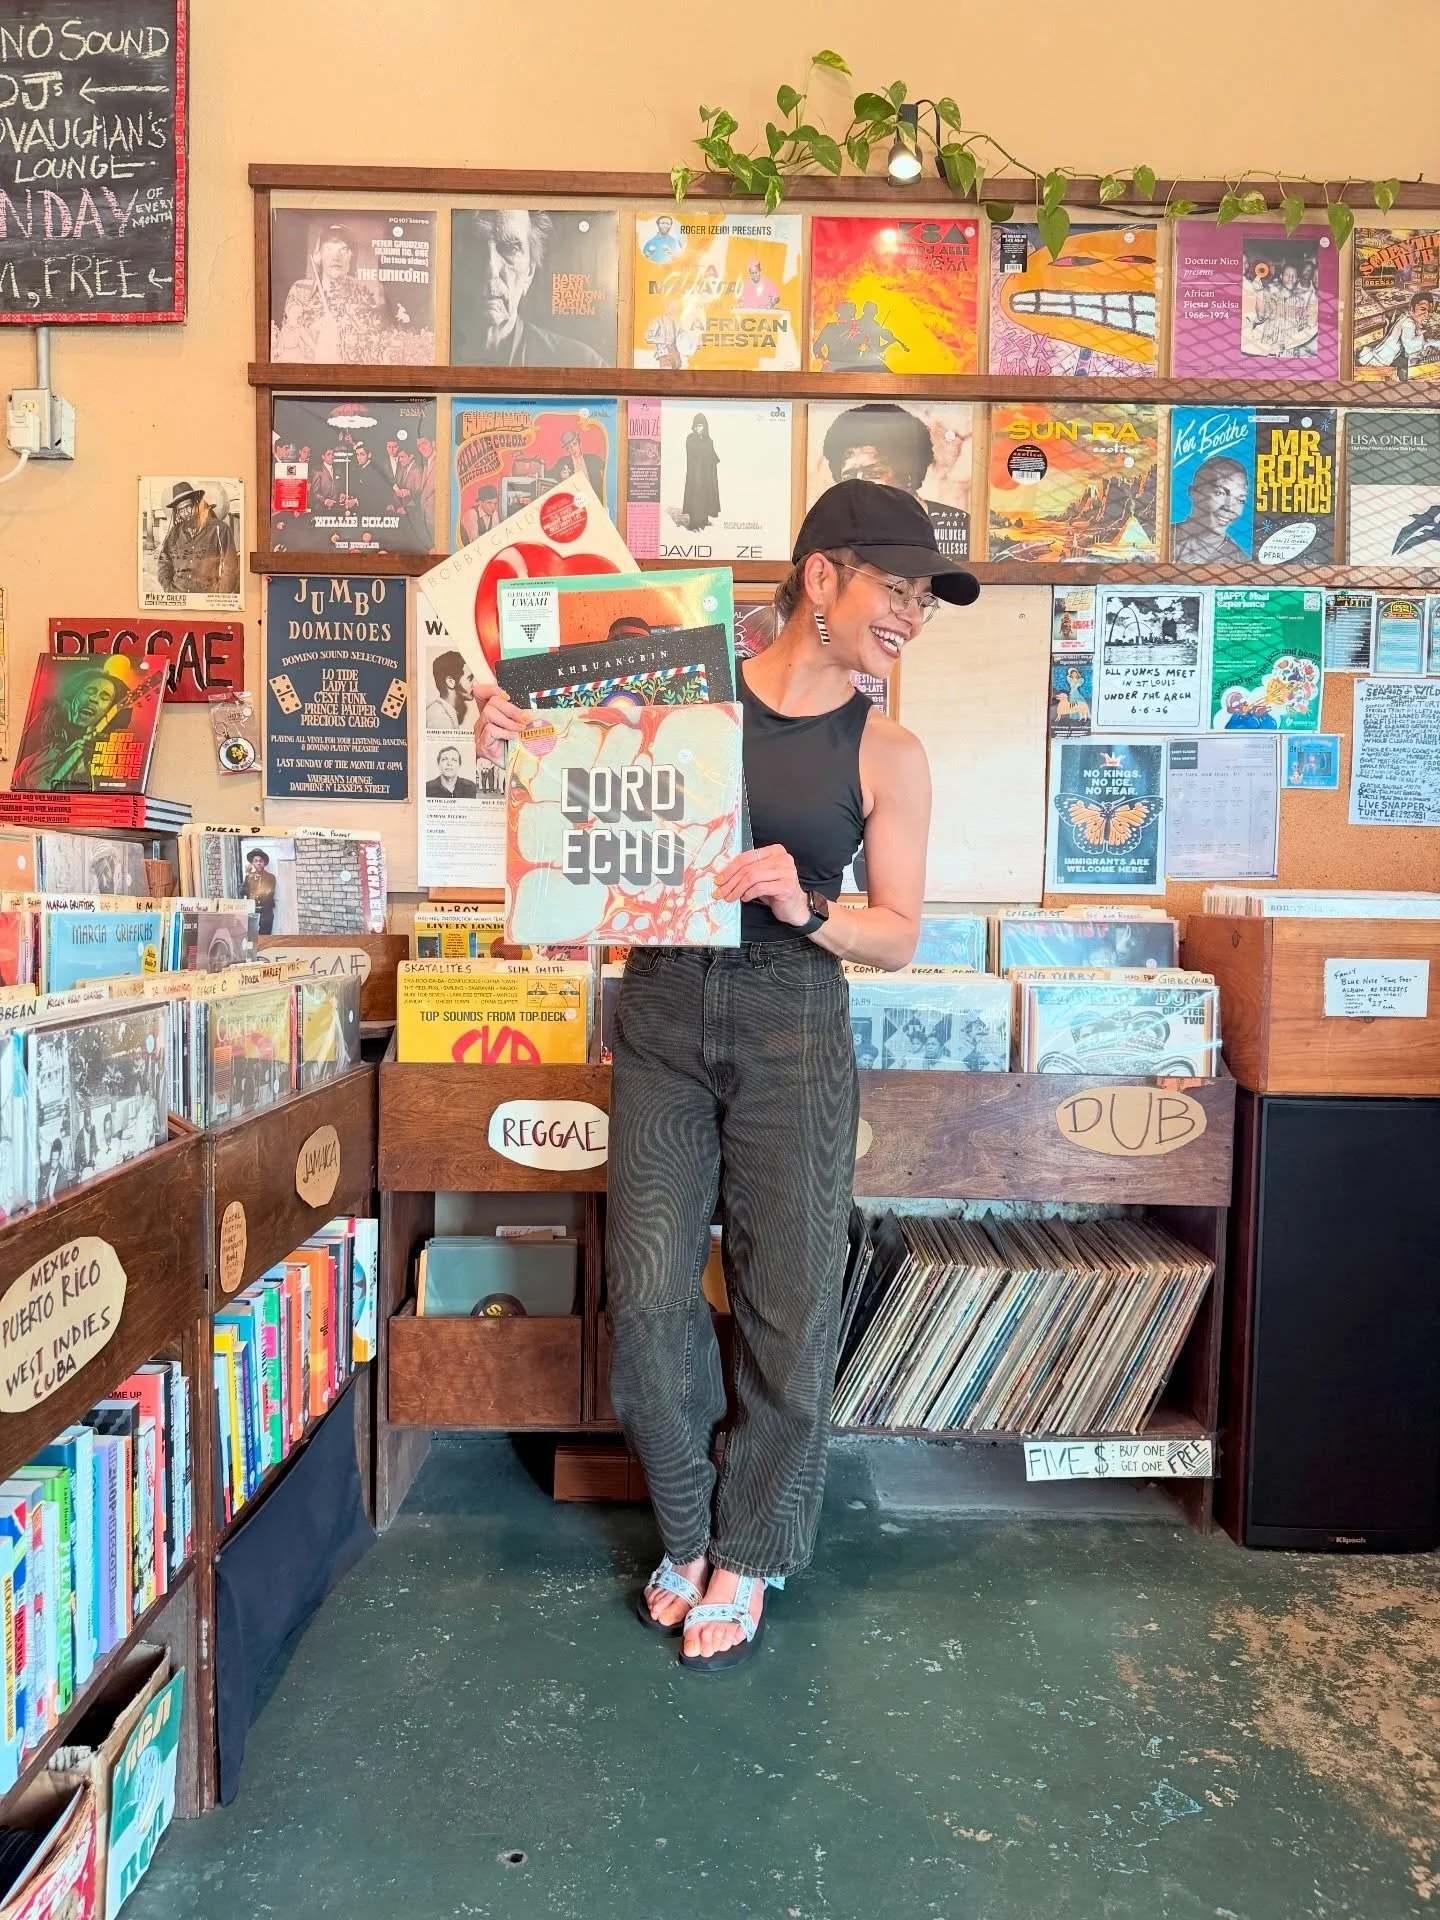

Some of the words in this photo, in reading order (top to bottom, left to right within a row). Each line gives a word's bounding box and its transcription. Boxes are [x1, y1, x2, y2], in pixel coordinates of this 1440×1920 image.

[59, 20, 170, 61] SOUND
[14, 155, 146, 184] LOUNGE
[147, 187, 164, 199] OF
[136, 198, 174, 214] EVERY
[132, 214, 173, 228] MONTH
[680, 225, 706, 235] ROGER
[732, 226, 772, 236] PRESENTS
[1220, 258, 1240, 266] Nico
[42, 254, 145, 298] FREE
[357, 268, 378, 280] THE
[378, 267, 429, 284] UNICORN
[1184, 270, 1214, 278] presents
[552, 282, 583, 290] DEAN
[1211, 300, 1240, 308] Sukisa
[689, 317, 788, 333] AFRICAN
[701, 333, 776, 348] FIESTA
[999, 330, 1055, 360] SEX
[629, 420, 650, 437] DAVID
[1007, 420, 1078, 441] SUN
[1092, 422, 1141, 441] RA
[1174, 419, 1196, 462] Ken
[1198, 414, 1248, 454] Boothe
[1351, 434, 1378, 445] LISA
[1380, 434, 1428, 446] O'NEILL
[1092, 444, 1140, 454] exotica
[1257, 455, 1332, 485] ROCK
[1257, 482, 1332, 514] STEADY
[315, 516, 358, 528] WILLIE
[362, 516, 400, 528] COLON
[736, 546, 762, 558] ZE
[1263, 551, 1286, 560] PEARL
[427, 546, 482, 588] BOBBY
[294, 578, 386, 616] JUMBO
[1217, 601, 1266, 610] Experience
[288, 621, 391, 642] DOMINOES
[282, 652, 318, 666] DOMINO
[320, 650, 348, 660] SOUND
[350, 652, 398, 668] SELECTORS
[1282, 648, 1297, 656] and
[558, 650, 668, 676] KHRUANGBIN
[322, 668, 334, 680] LO
[336, 668, 358, 680] TIDE
[1125, 668, 1160, 676] PUNKS
[1166, 668, 1196, 678] MEET
[322, 680, 346, 692] LADY
[349, 680, 359, 693] LI
[342, 692, 366, 704] FUNK
[1104, 691, 1138, 700] UNDER
[1143, 692, 1160, 700] THE
[1164, 692, 1192, 702] ARCH
[304, 702, 338, 715] PRINCE
[341, 704, 376, 716] PAUPER
[300, 714, 346, 727] PRECIOUS
[348, 716, 380, 728] CARGO
[271, 734, 294, 742] PLAYING
[306, 736, 324, 744] VINYL
[336, 736, 351, 744] YOUR
[352, 745, 380, 753] PLEASURE
[276, 758, 294, 768] LAST
[296, 758, 322, 768] SUNDAY
[324, 760, 334, 769] OF
[335, 760, 348, 770] THE
[350, 760, 375, 770] MONTH
[376, 761, 386, 770] AT
[307, 774, 345, 785] VAUGHAN'S
[346, 775, 373, 785] LOUNGE
[1084, 770, 1100, 778] NO
[1104, 770, 1142, 778] KINGS.
[290, 782, 324, 792] DAUPHINE
[364, 784, 390, 794] STREET
[1092, 778, 1108, 786] NO
[561, 764, 681, 820] LORD
[1086, 787, 1102, 795] NO
[1106, 787, 1138, 795] FEAR.
[1358, 800, 1380, 810] LIVE
[1381, 801, 1426, 812] SNAPPER
[562, 829, 681, 883] ECHO
[1064, 858, 1126, 866] IMMIGRANTS
[366, 846, 384, 921] MICHAEL
[72, 924, 108, 945] MARCIA
[262, 966, 282, 980] MARLEY
[404, 964, 472, 974] SKATALITES
[508, 966, 530, 974] SLIM
[535, 966, 564, 974] SMITH
[1156, 990, 1199, 1006] DUB
[420, 1011, 441, 1022] TOP
[443, 1011, 483, 1022] SOUNDS
[486, 1011, 516, 1022] FROM
[1162, 1007, 1204, 1016] CHAPTER
[1183, 1016, 1204, 1025] TWO
[1064, 1092, 1196, 1150] DUB
[502, 1117, 606, 1152] REGGAE
[302, 1140, 338, 1184] JAMAICA
[30, 1246, 80, 1292] MEXICO
[2, 1291, 55, 1348] PUERTO
[62, 1258, 101, 1308] RICO
[6, 1346, 46, 1399] WEST
[53, 1305, 111, 1360] INDIES
[32, 1353, 76, 1400] CUBA
[129, 1390, 142, 1399] UP
[1028, 1446, 1090, 1477] FIVE
[1120, 1445, 1138, 1458] BUY
[1143, 1446, 1165, 1458] ONE
[1168, 1440, 1208, 1475] FREE
[1121, 1462, 1138, 1472] GET
[1142, 1461, 1164, 1472] ONE
[60, 1542, 72, 1627] FREAKS
[123, 1689, 172, 1787] RCA
[120, 1796, 166, 1903] RCA
